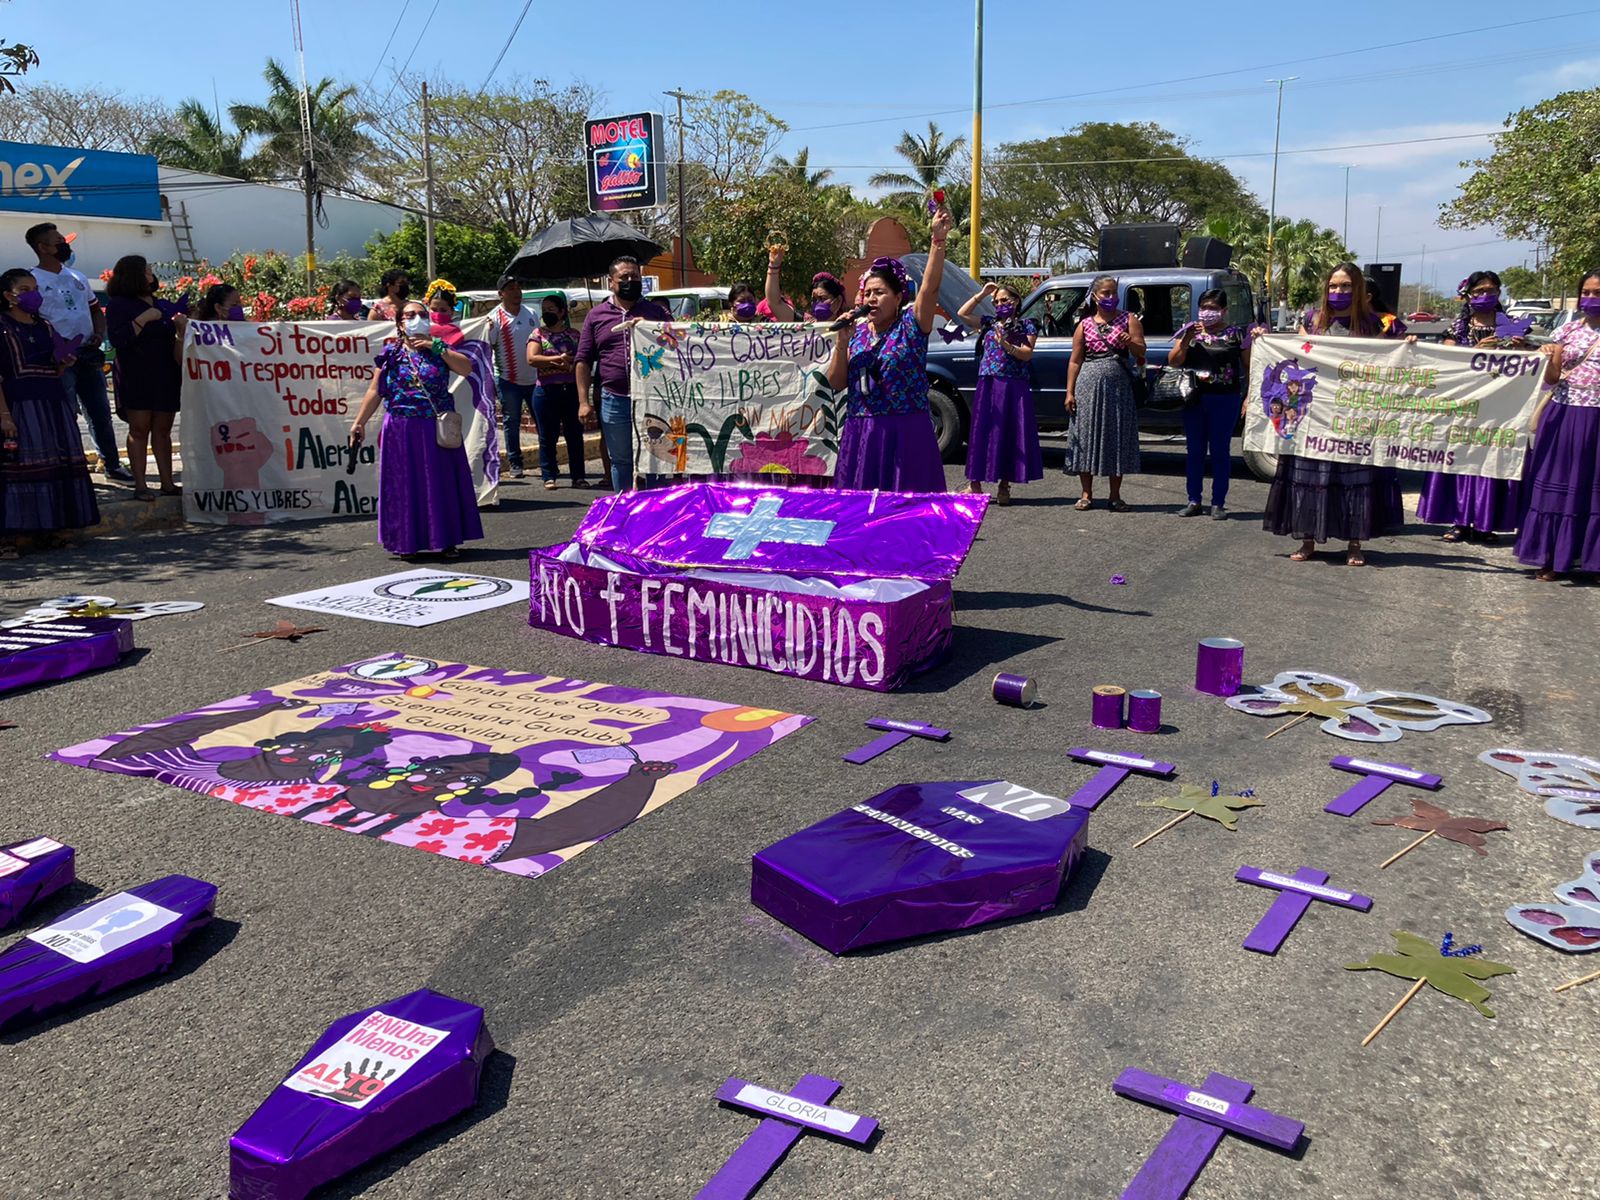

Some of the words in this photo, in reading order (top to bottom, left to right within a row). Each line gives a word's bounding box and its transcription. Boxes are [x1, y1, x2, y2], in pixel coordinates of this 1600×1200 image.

[590, 118, 648, 145] MOTEL
[601, 170, 643, 192] gallito
[257, 325, 283, 356] Si
[289, 324, 370, 354] tocan
[674, 333, 718, 381] NOS
[731, 330, 832, 364] QUEREMOS
[1470, 352, 1540, 377] GM8M
[186, 357, 232, 381] una
[241, 355, 374, 393] respondemos
[719, 370, 782, 408] LIBRES
[796, 365, 819, 400] Y
[282, 387, 348, 416] todas
[770, 404, 827, 437] MIEDO
[1408, 422, 1435, 442] CA
[1446, 425, 1518, 448] GUNAA
[1305, 435, 1372, 457] MUJERES
[1386, 445, 1455, 466] INDIGENAS
[194, 490, 249, 512] VIVAS
[251, 490, 261, 510] Y
[265, 489, 312, 509] LIBRES
[538, 564, 584, 636] NO
[641, 578, 885, 685] FEMINICIDIOS
[439, 681, 507, 697] Gunaa
[939, 806, 984, 825] MAS
[956, 781, 1071, 821] NO
[42, 934, 71, 948] NO
[345, 1028, 420, 1061] Menos
[362, 1013, 439, 1047] #NiUna
[301, 1062, 386, 1095] ALTO
[766, 1095, 829, 1122] GLORIA
[1187, 1094, 1225, 1111] GEMA
